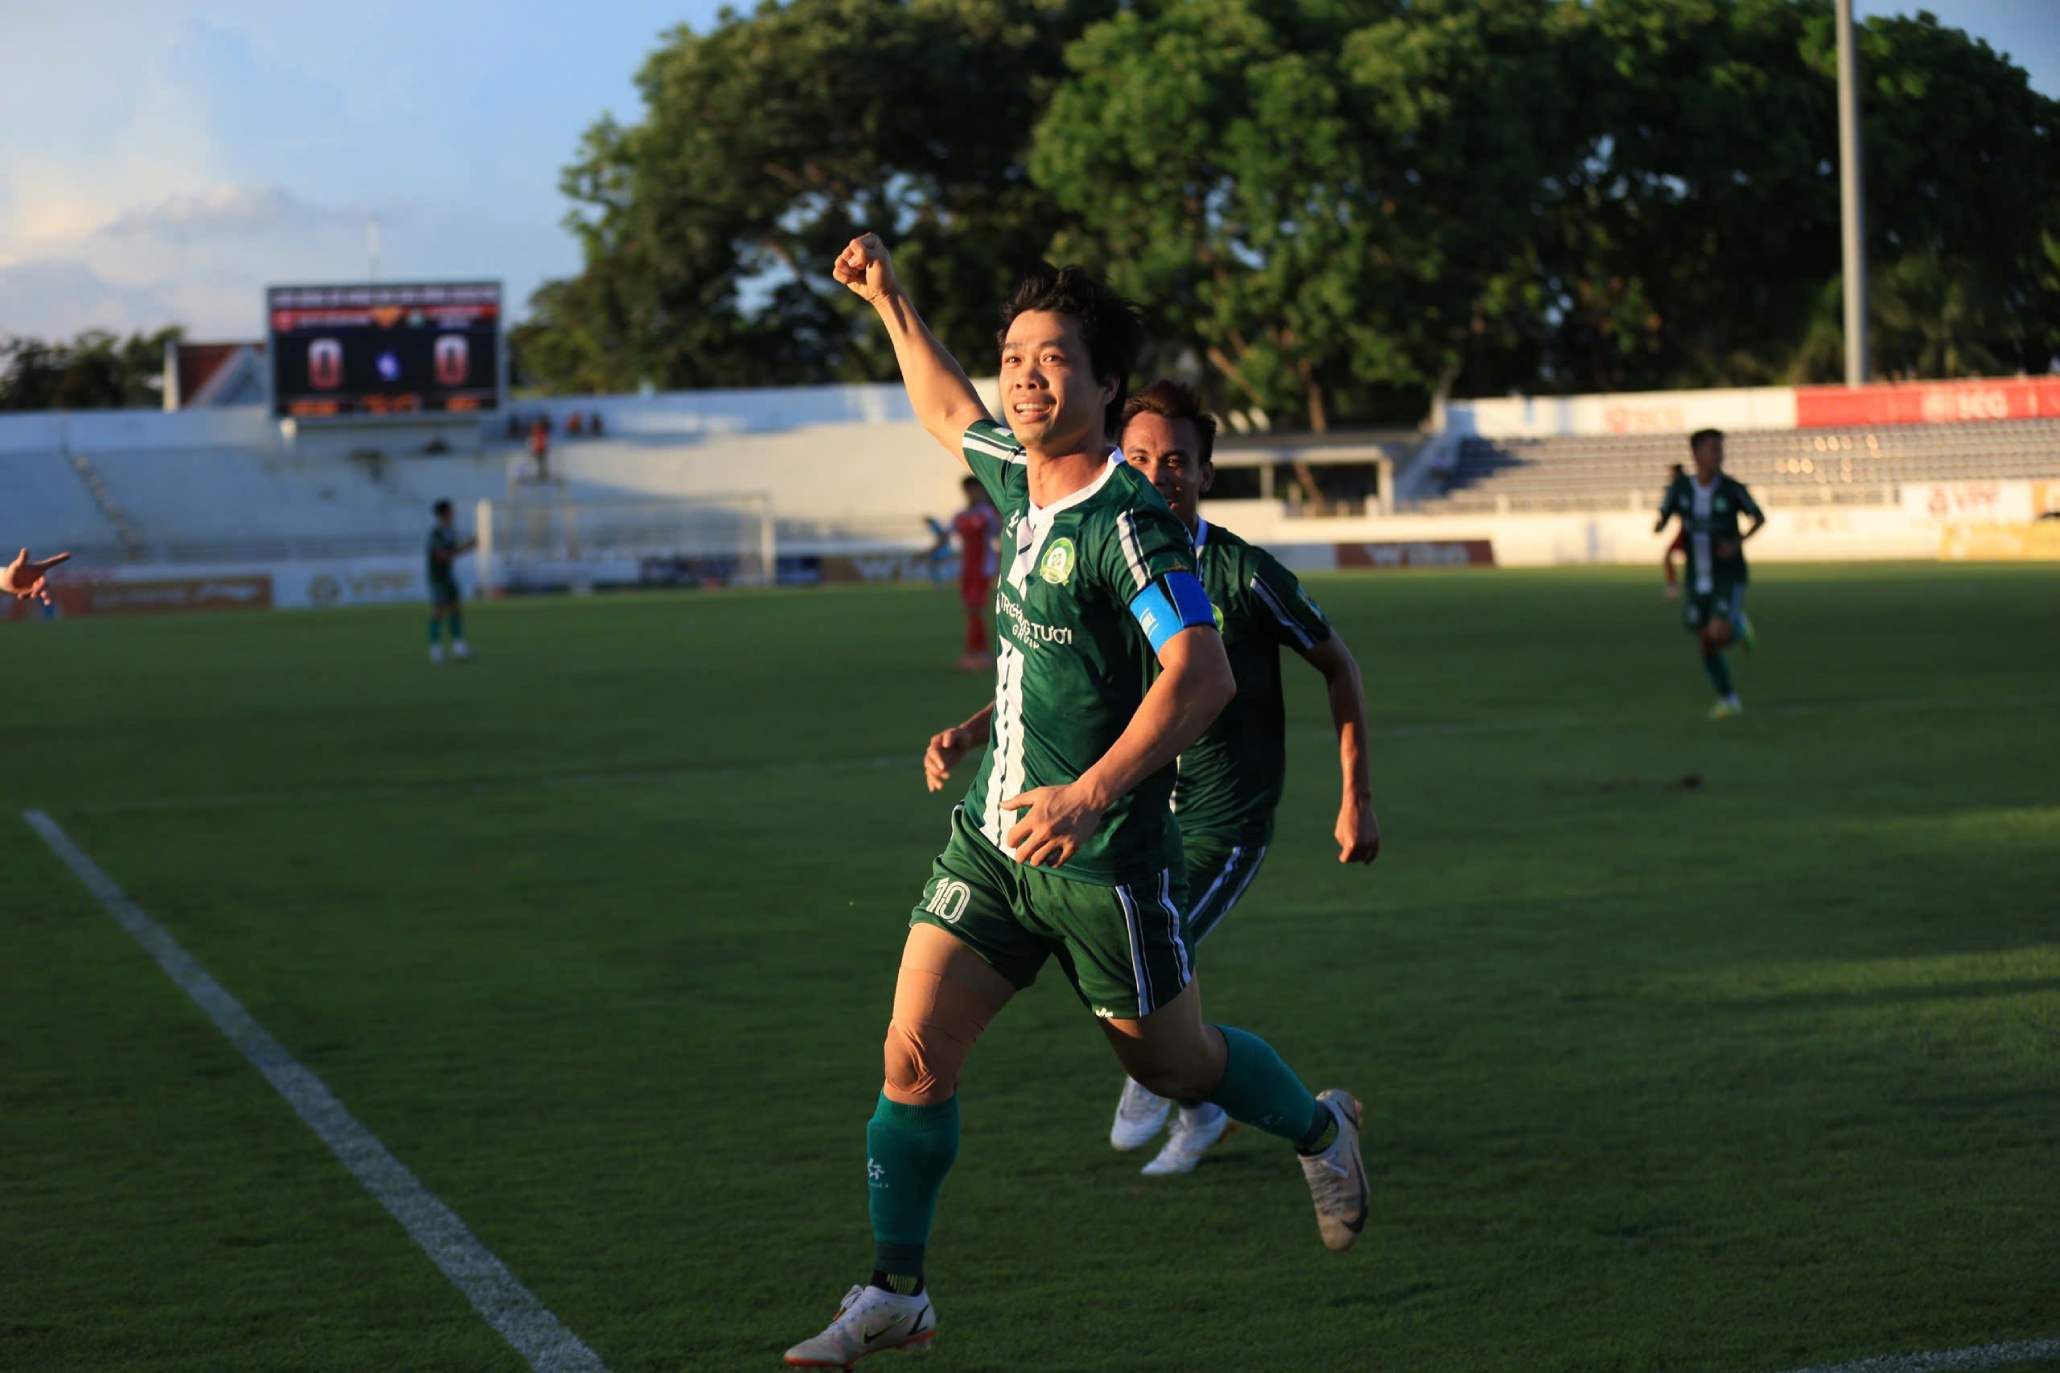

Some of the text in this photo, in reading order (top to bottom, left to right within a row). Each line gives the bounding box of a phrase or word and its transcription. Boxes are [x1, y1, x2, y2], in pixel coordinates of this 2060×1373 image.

[308, 333, 469, 390] 0 0
[1031, 622, 1072, 645] TƯƠI
[926, 877, 971, 924] 10
